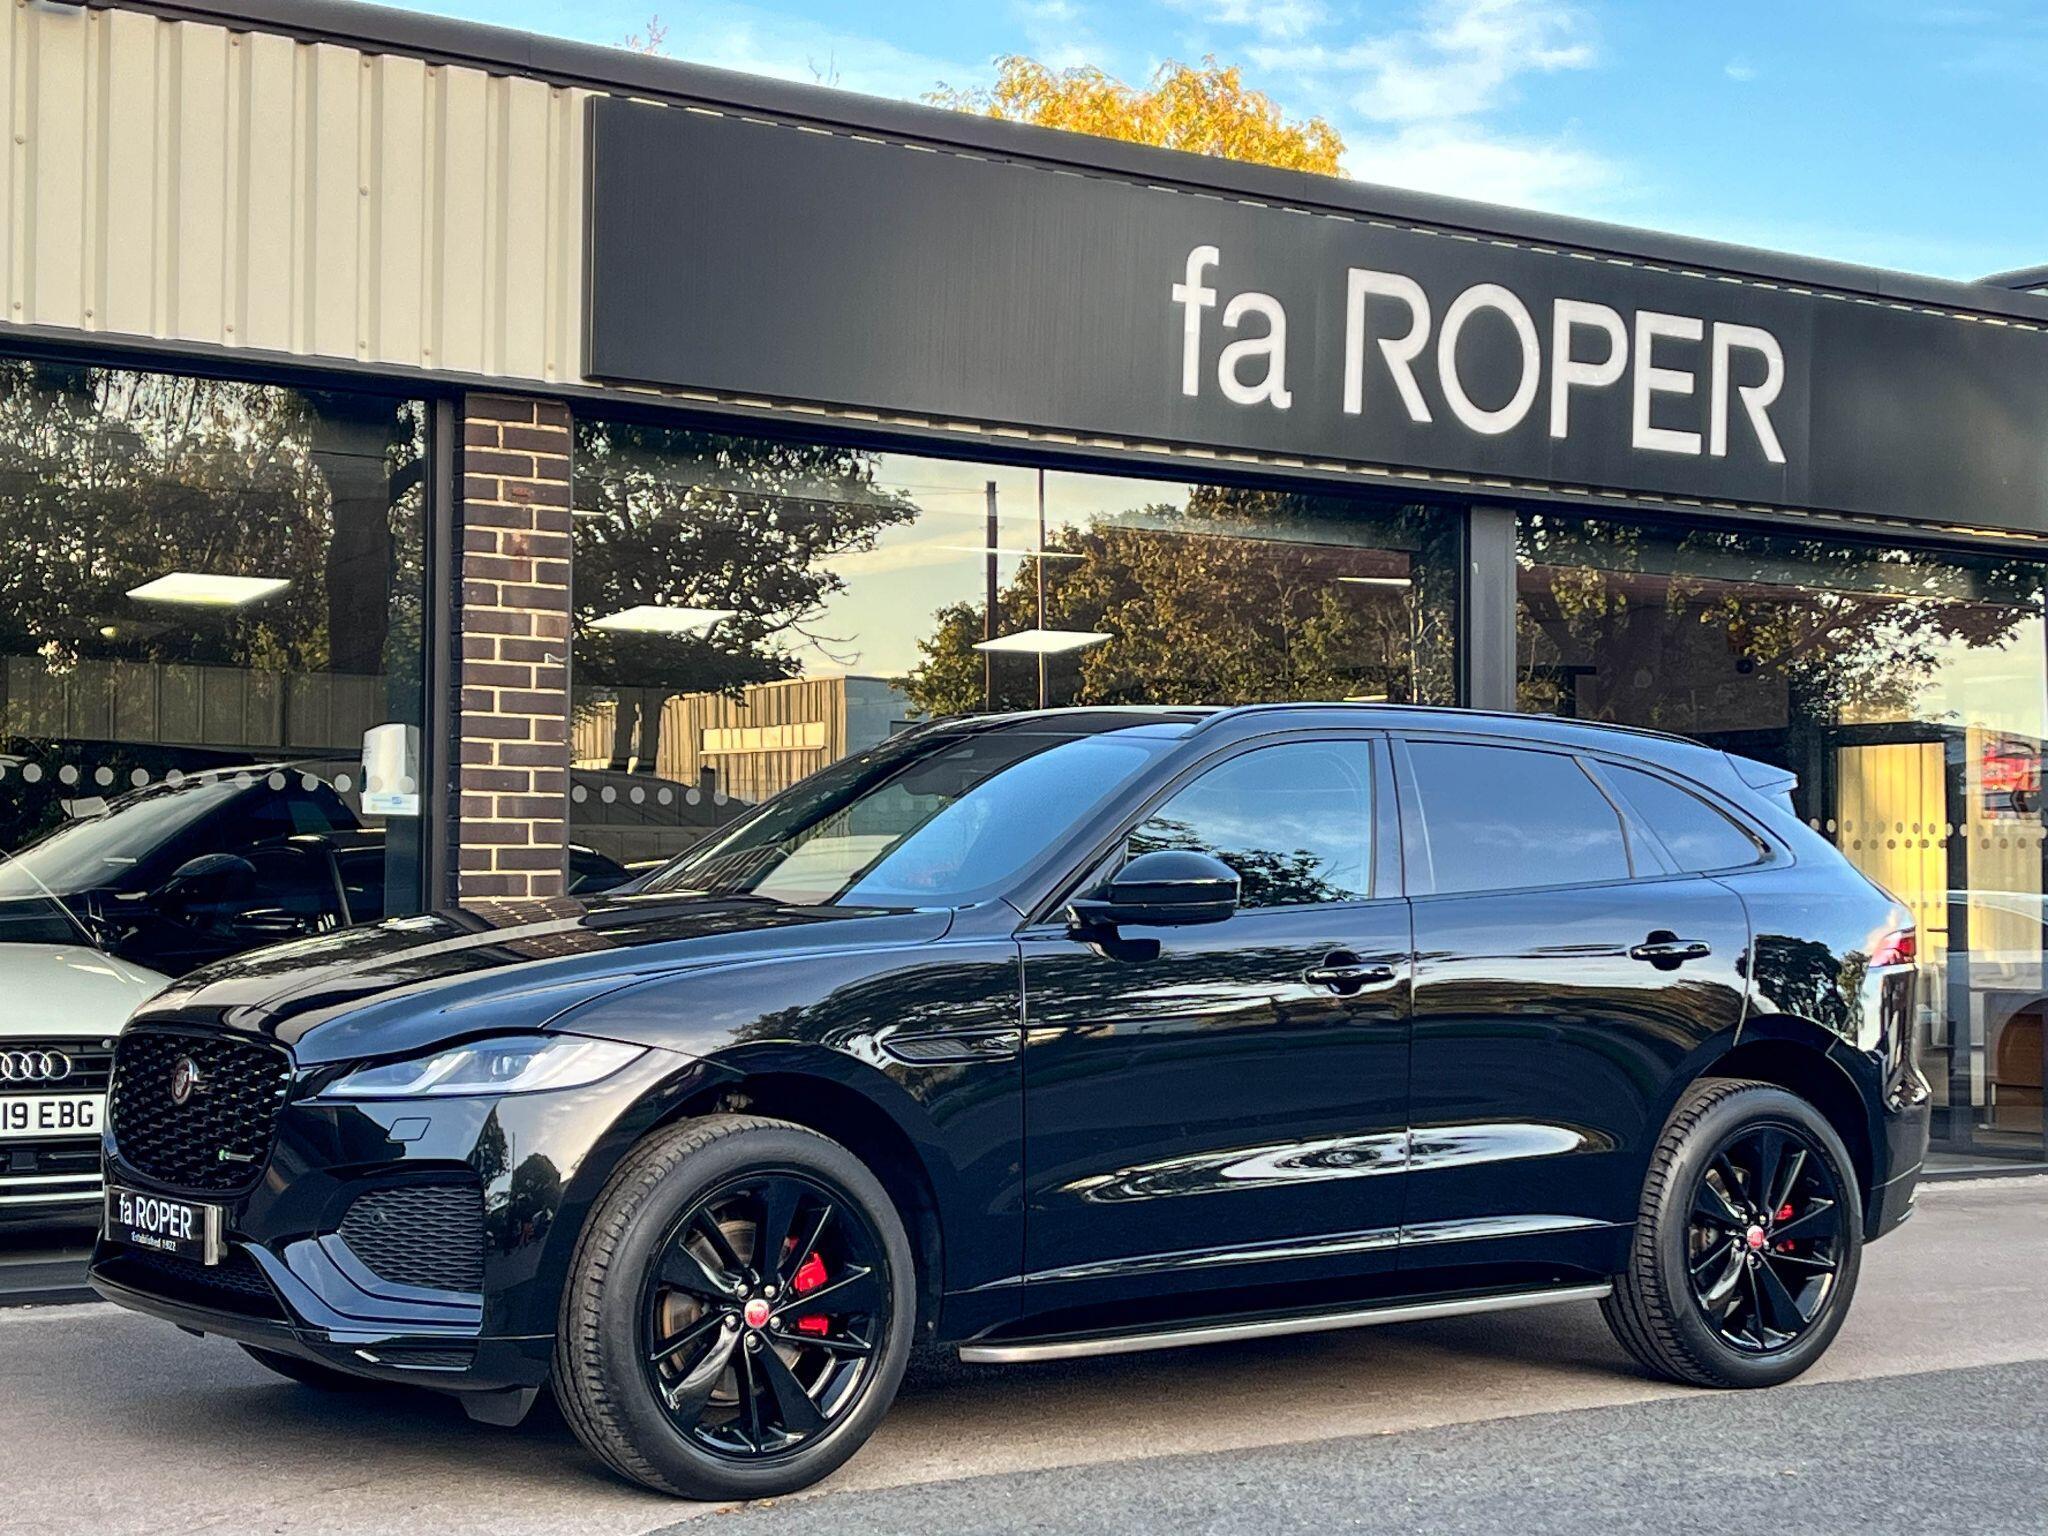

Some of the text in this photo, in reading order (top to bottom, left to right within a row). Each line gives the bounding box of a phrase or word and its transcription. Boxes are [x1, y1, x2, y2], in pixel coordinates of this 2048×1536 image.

[1171, 244, 1787, 464] fa ROPER
[38, 1100, 94, 1129] EBG
[119, 1192, 192, 1240] fa ROPER
